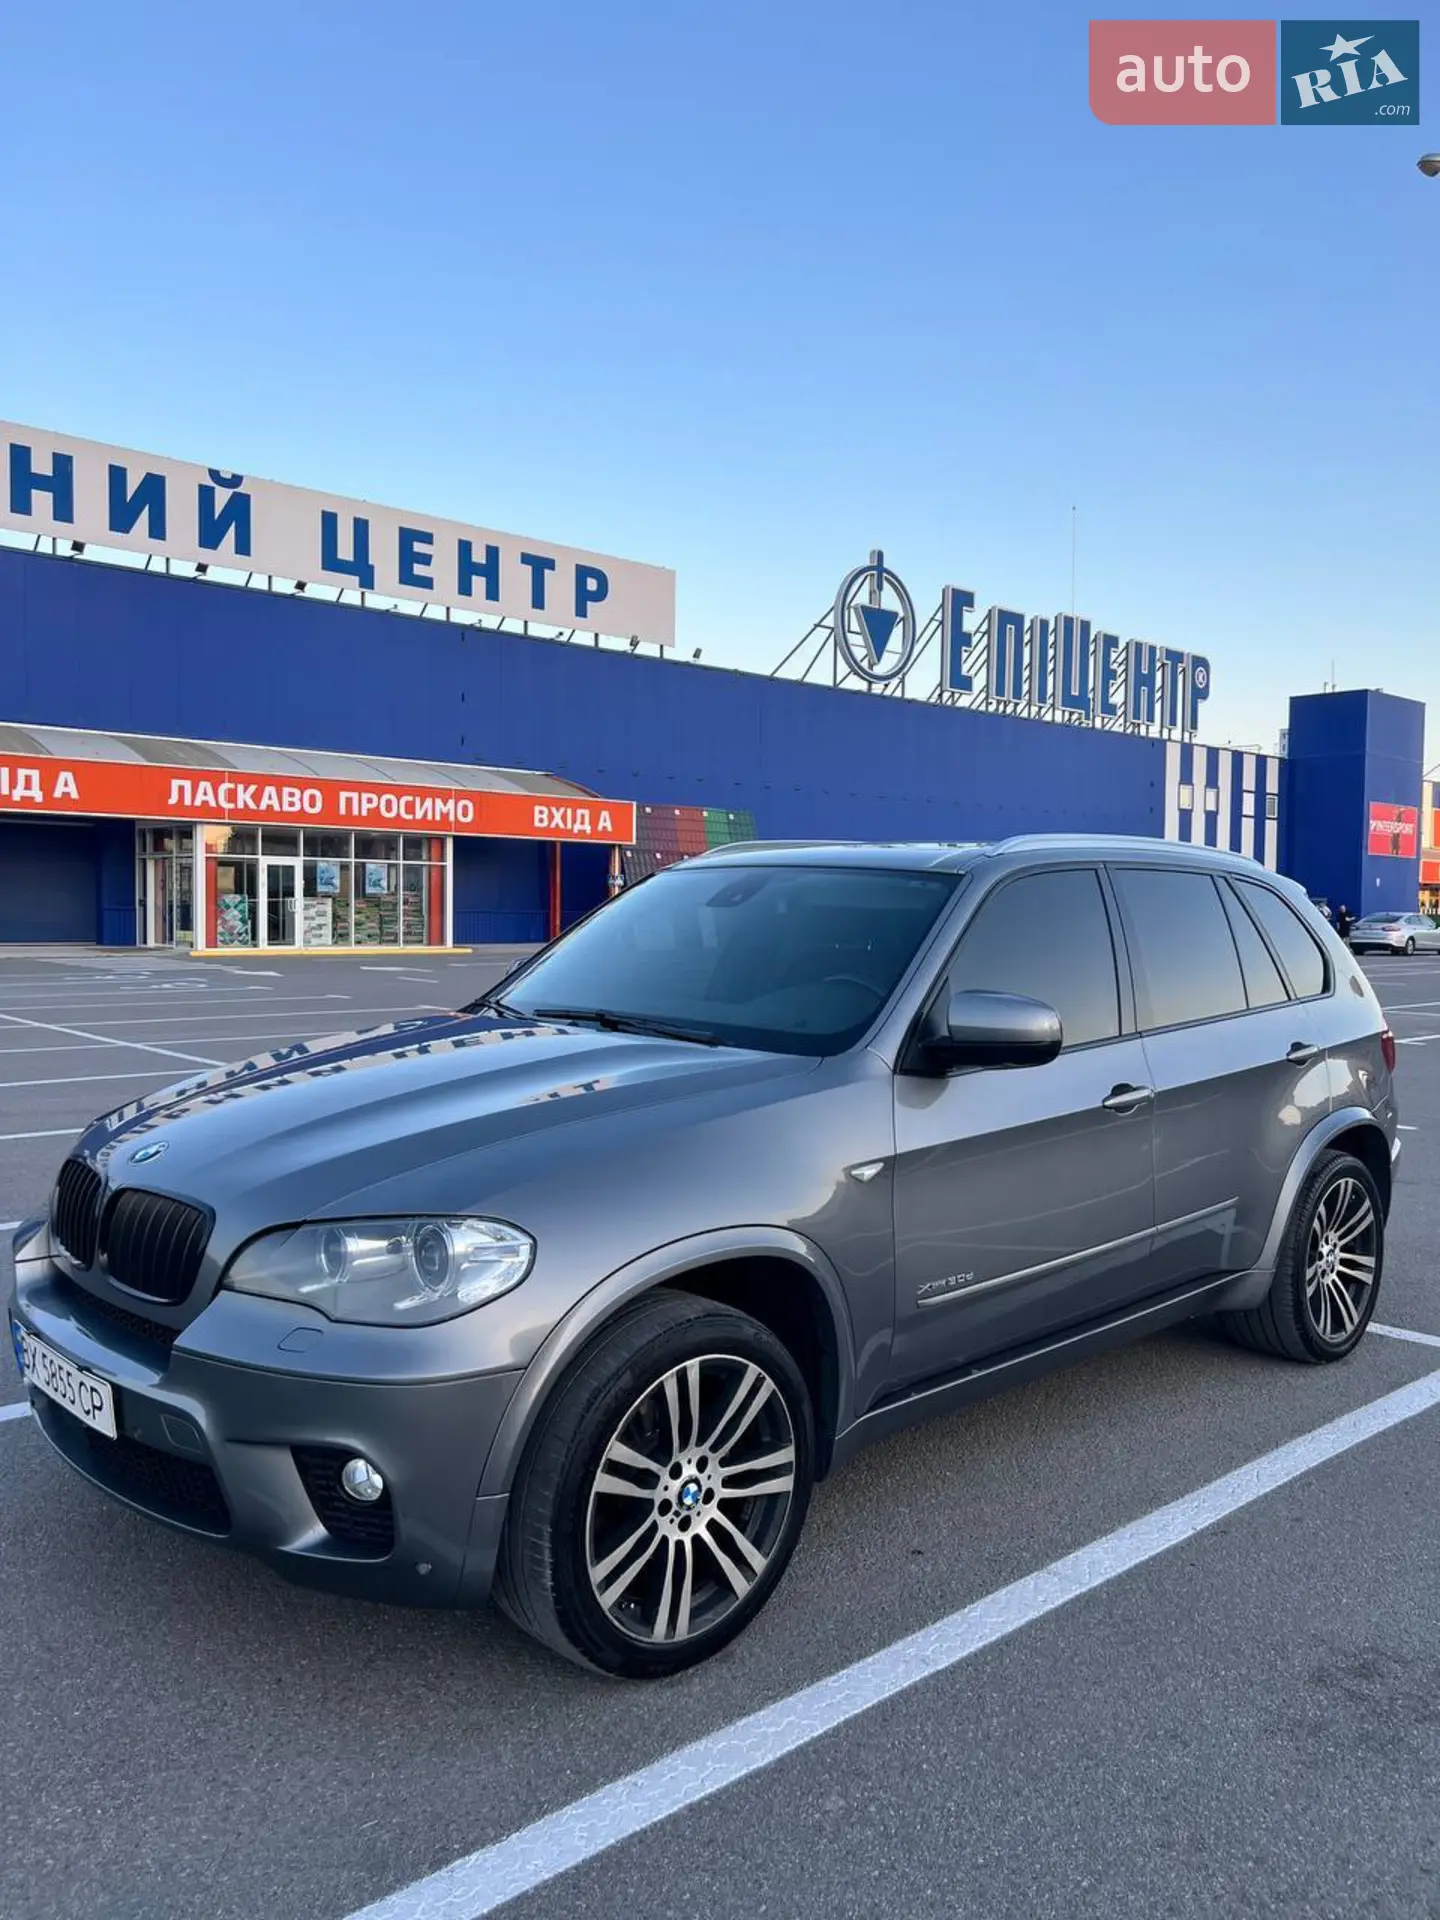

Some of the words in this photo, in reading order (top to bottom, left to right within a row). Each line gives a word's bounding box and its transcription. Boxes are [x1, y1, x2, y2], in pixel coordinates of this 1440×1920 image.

[10, 442, 251, 557] НИЙ
[321, 510, 609, 618] ЦЕНТР
[942, 584, 1211, 733] ЕПІЦЕНТР
[53, 770, 79, 800] А
[168, 778, 323, 815] ЛАСКАВО
[338, 791, 474, 823] ПРОСИМО
[533, 804, 592, 836] ВХІД
[597, 808, 613, 833] А
[42, 1352, 76, 1405] 5855
[78, 1381, 104, 1420] CP
